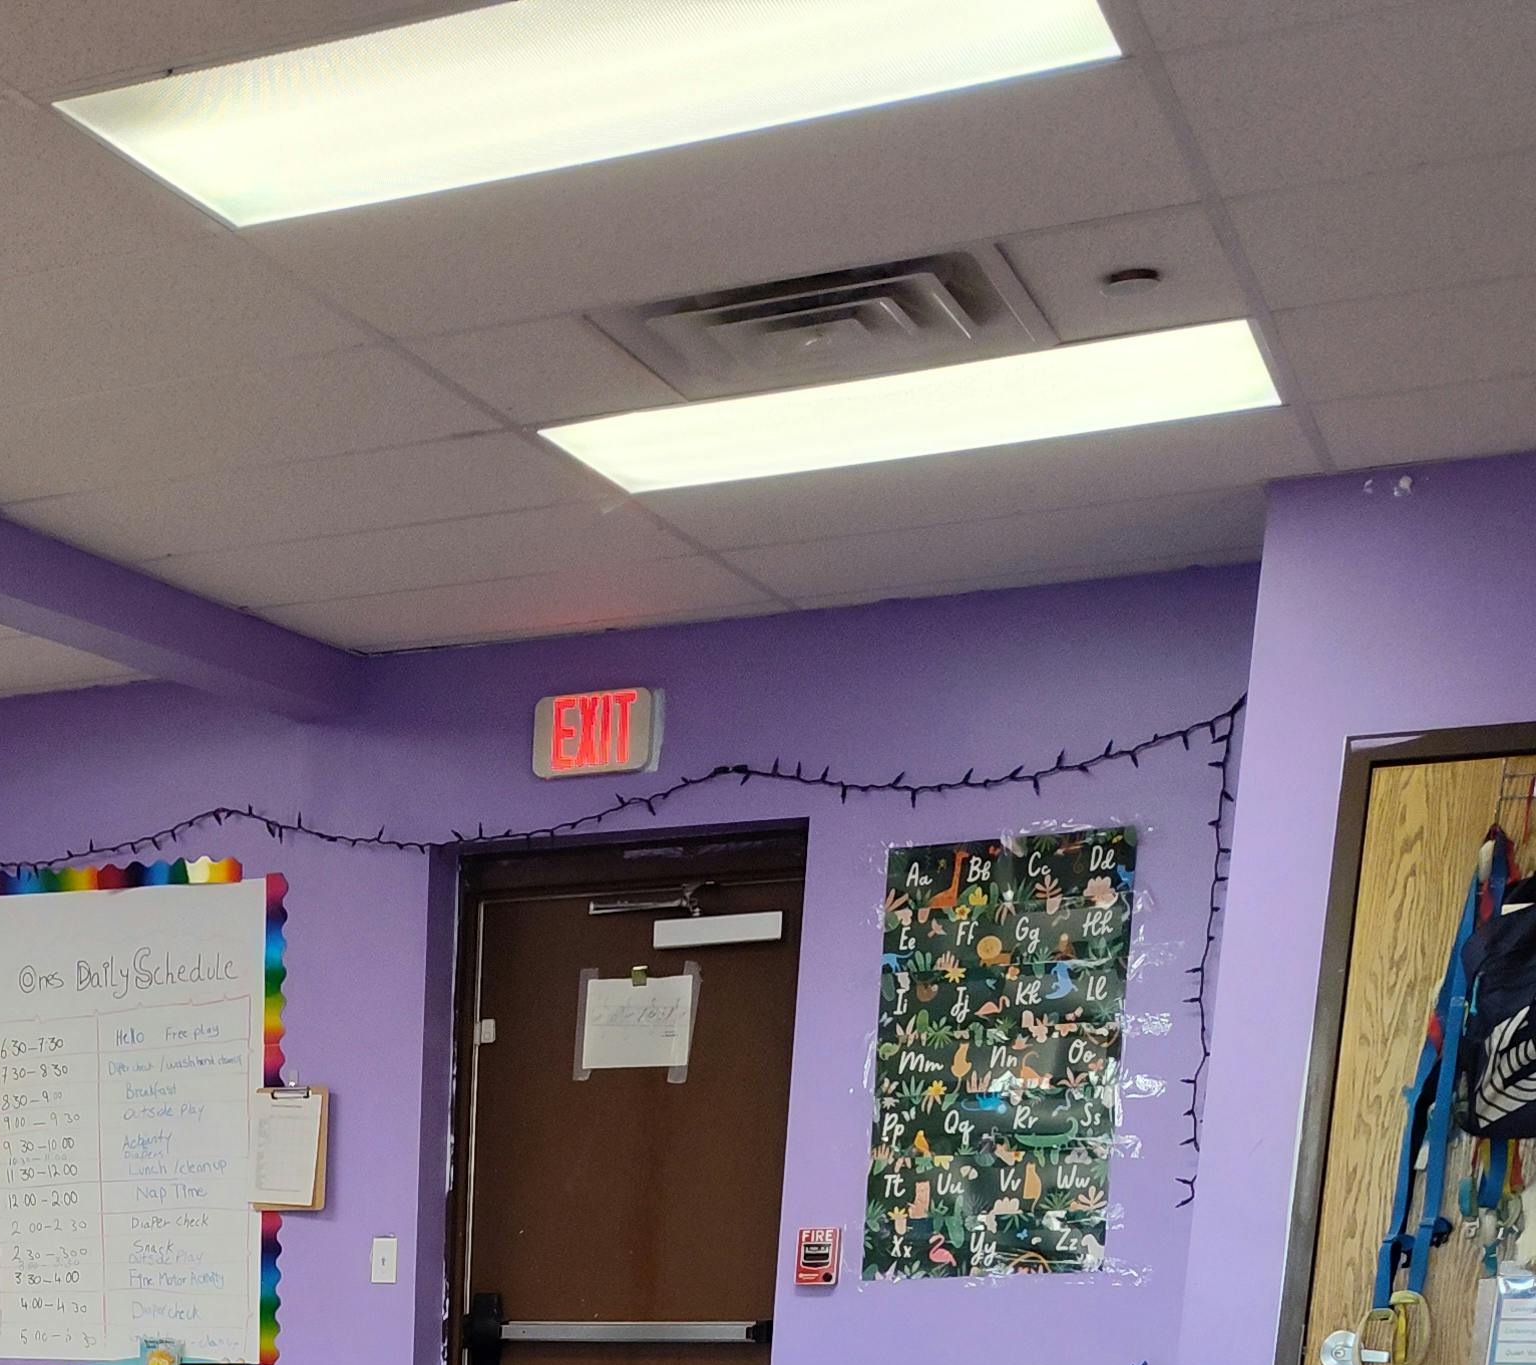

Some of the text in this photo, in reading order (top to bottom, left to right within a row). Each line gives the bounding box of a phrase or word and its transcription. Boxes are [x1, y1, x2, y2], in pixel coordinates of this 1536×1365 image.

[551, 690, 638, 771] EXIT
[906, 845, 1116, 887] Aa Bb Cc Dd
[899, 910, 1114, 953] Ee Ff Gg Hh
[19, 946, 239, 999] Ones Daily Schedule
[893, 975, 1108, 1023] Ii Jj Kk Ll
[116, 1024, 220, 1046] Hello Free play
[898, 1037, 1096, 1075] Mm Nn Oo
[882, 1102, 1101, 1148] Pp Qq Rr Ss
[128, 1160, 167, 1175] Lunch
[884, 1165, 1091, 1197] Tt Uu Vv Ww
[136, 1186, 166, 1203] Nap
[133, 1239, 174, 1255] Snack
[802, 1230, 834, 1242] FIRE
[891, 1228, 1077, 1266] Xx Yy Zz
